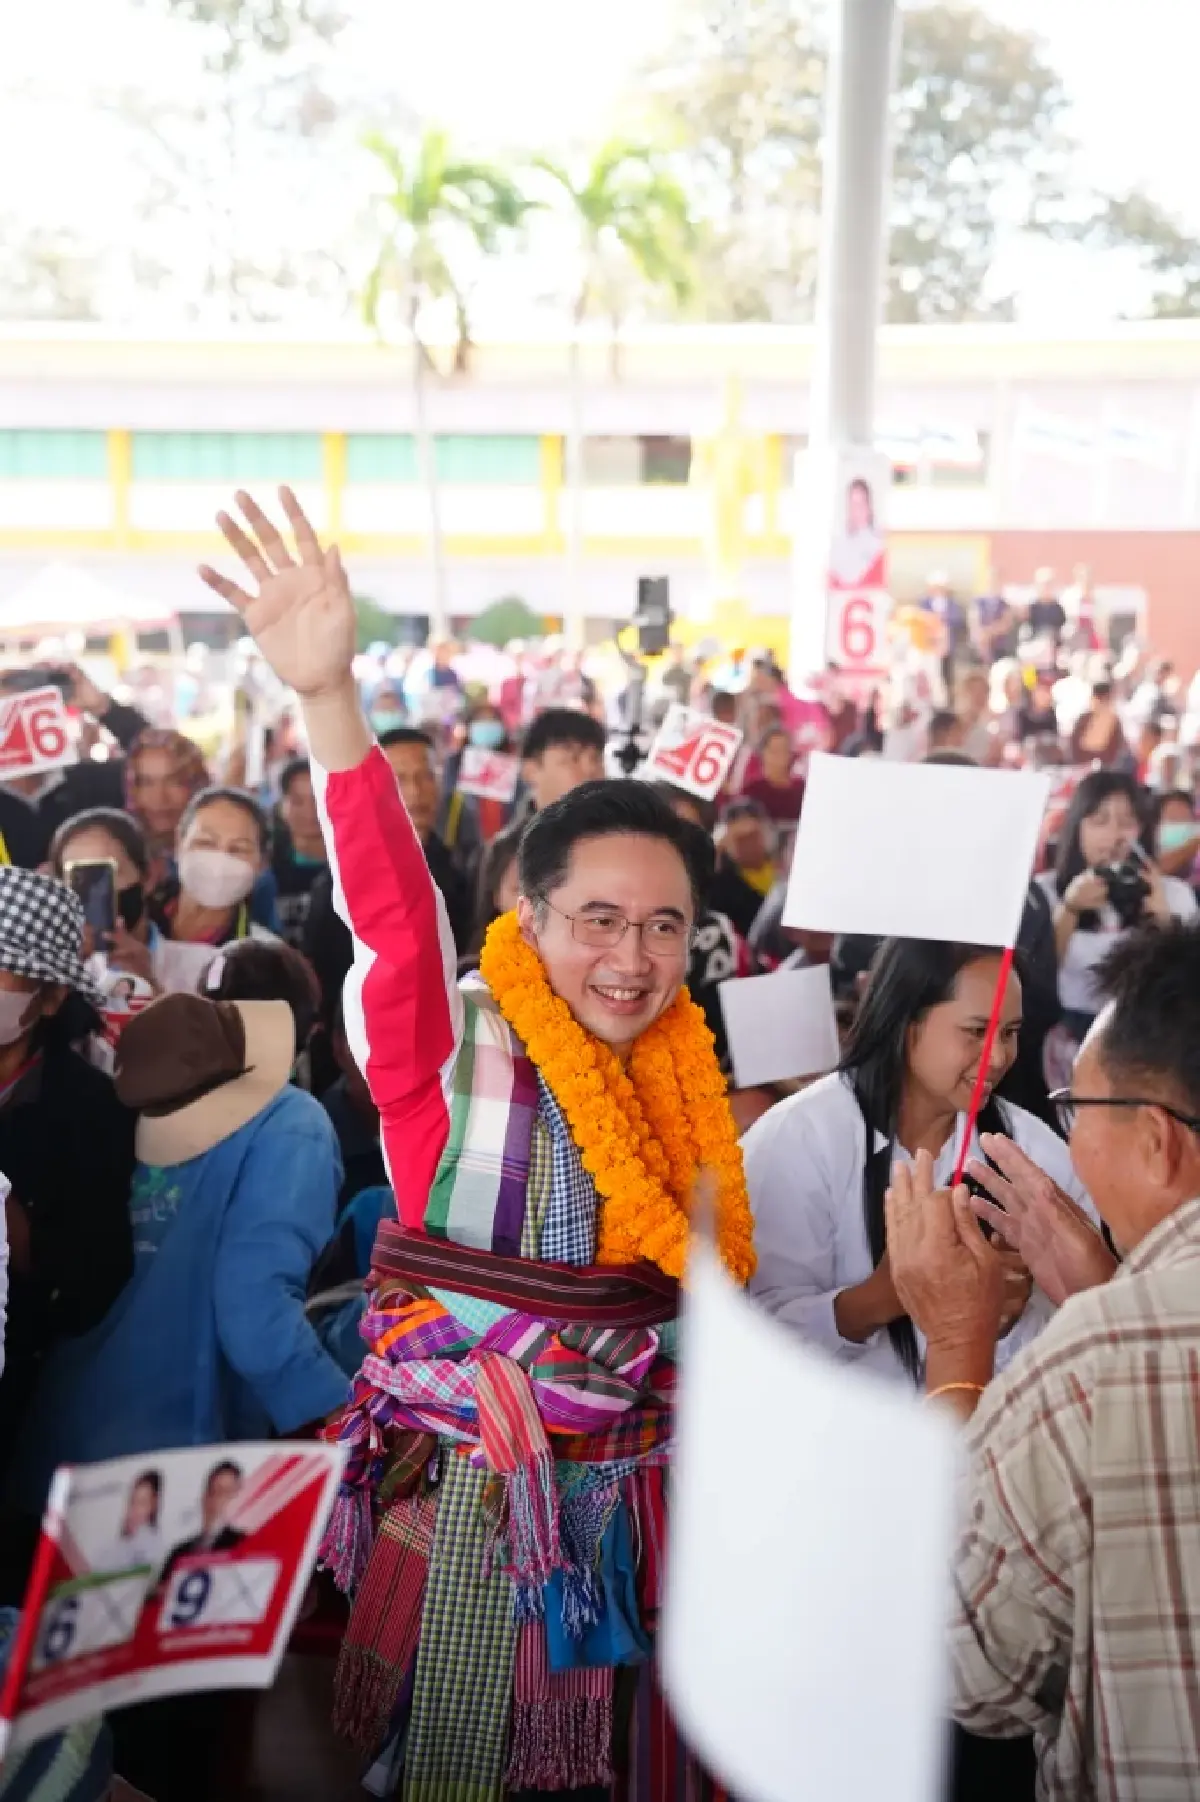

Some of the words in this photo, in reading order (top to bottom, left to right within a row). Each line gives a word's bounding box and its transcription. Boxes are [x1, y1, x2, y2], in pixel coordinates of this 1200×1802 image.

[838, 597, 875, 660] 6
[30, 708, 67, 758] 6
[692, 739, 727, 785] 6
[43, 1594, 80, 1660] 6
[171, 1568, 213, 1628] 9
